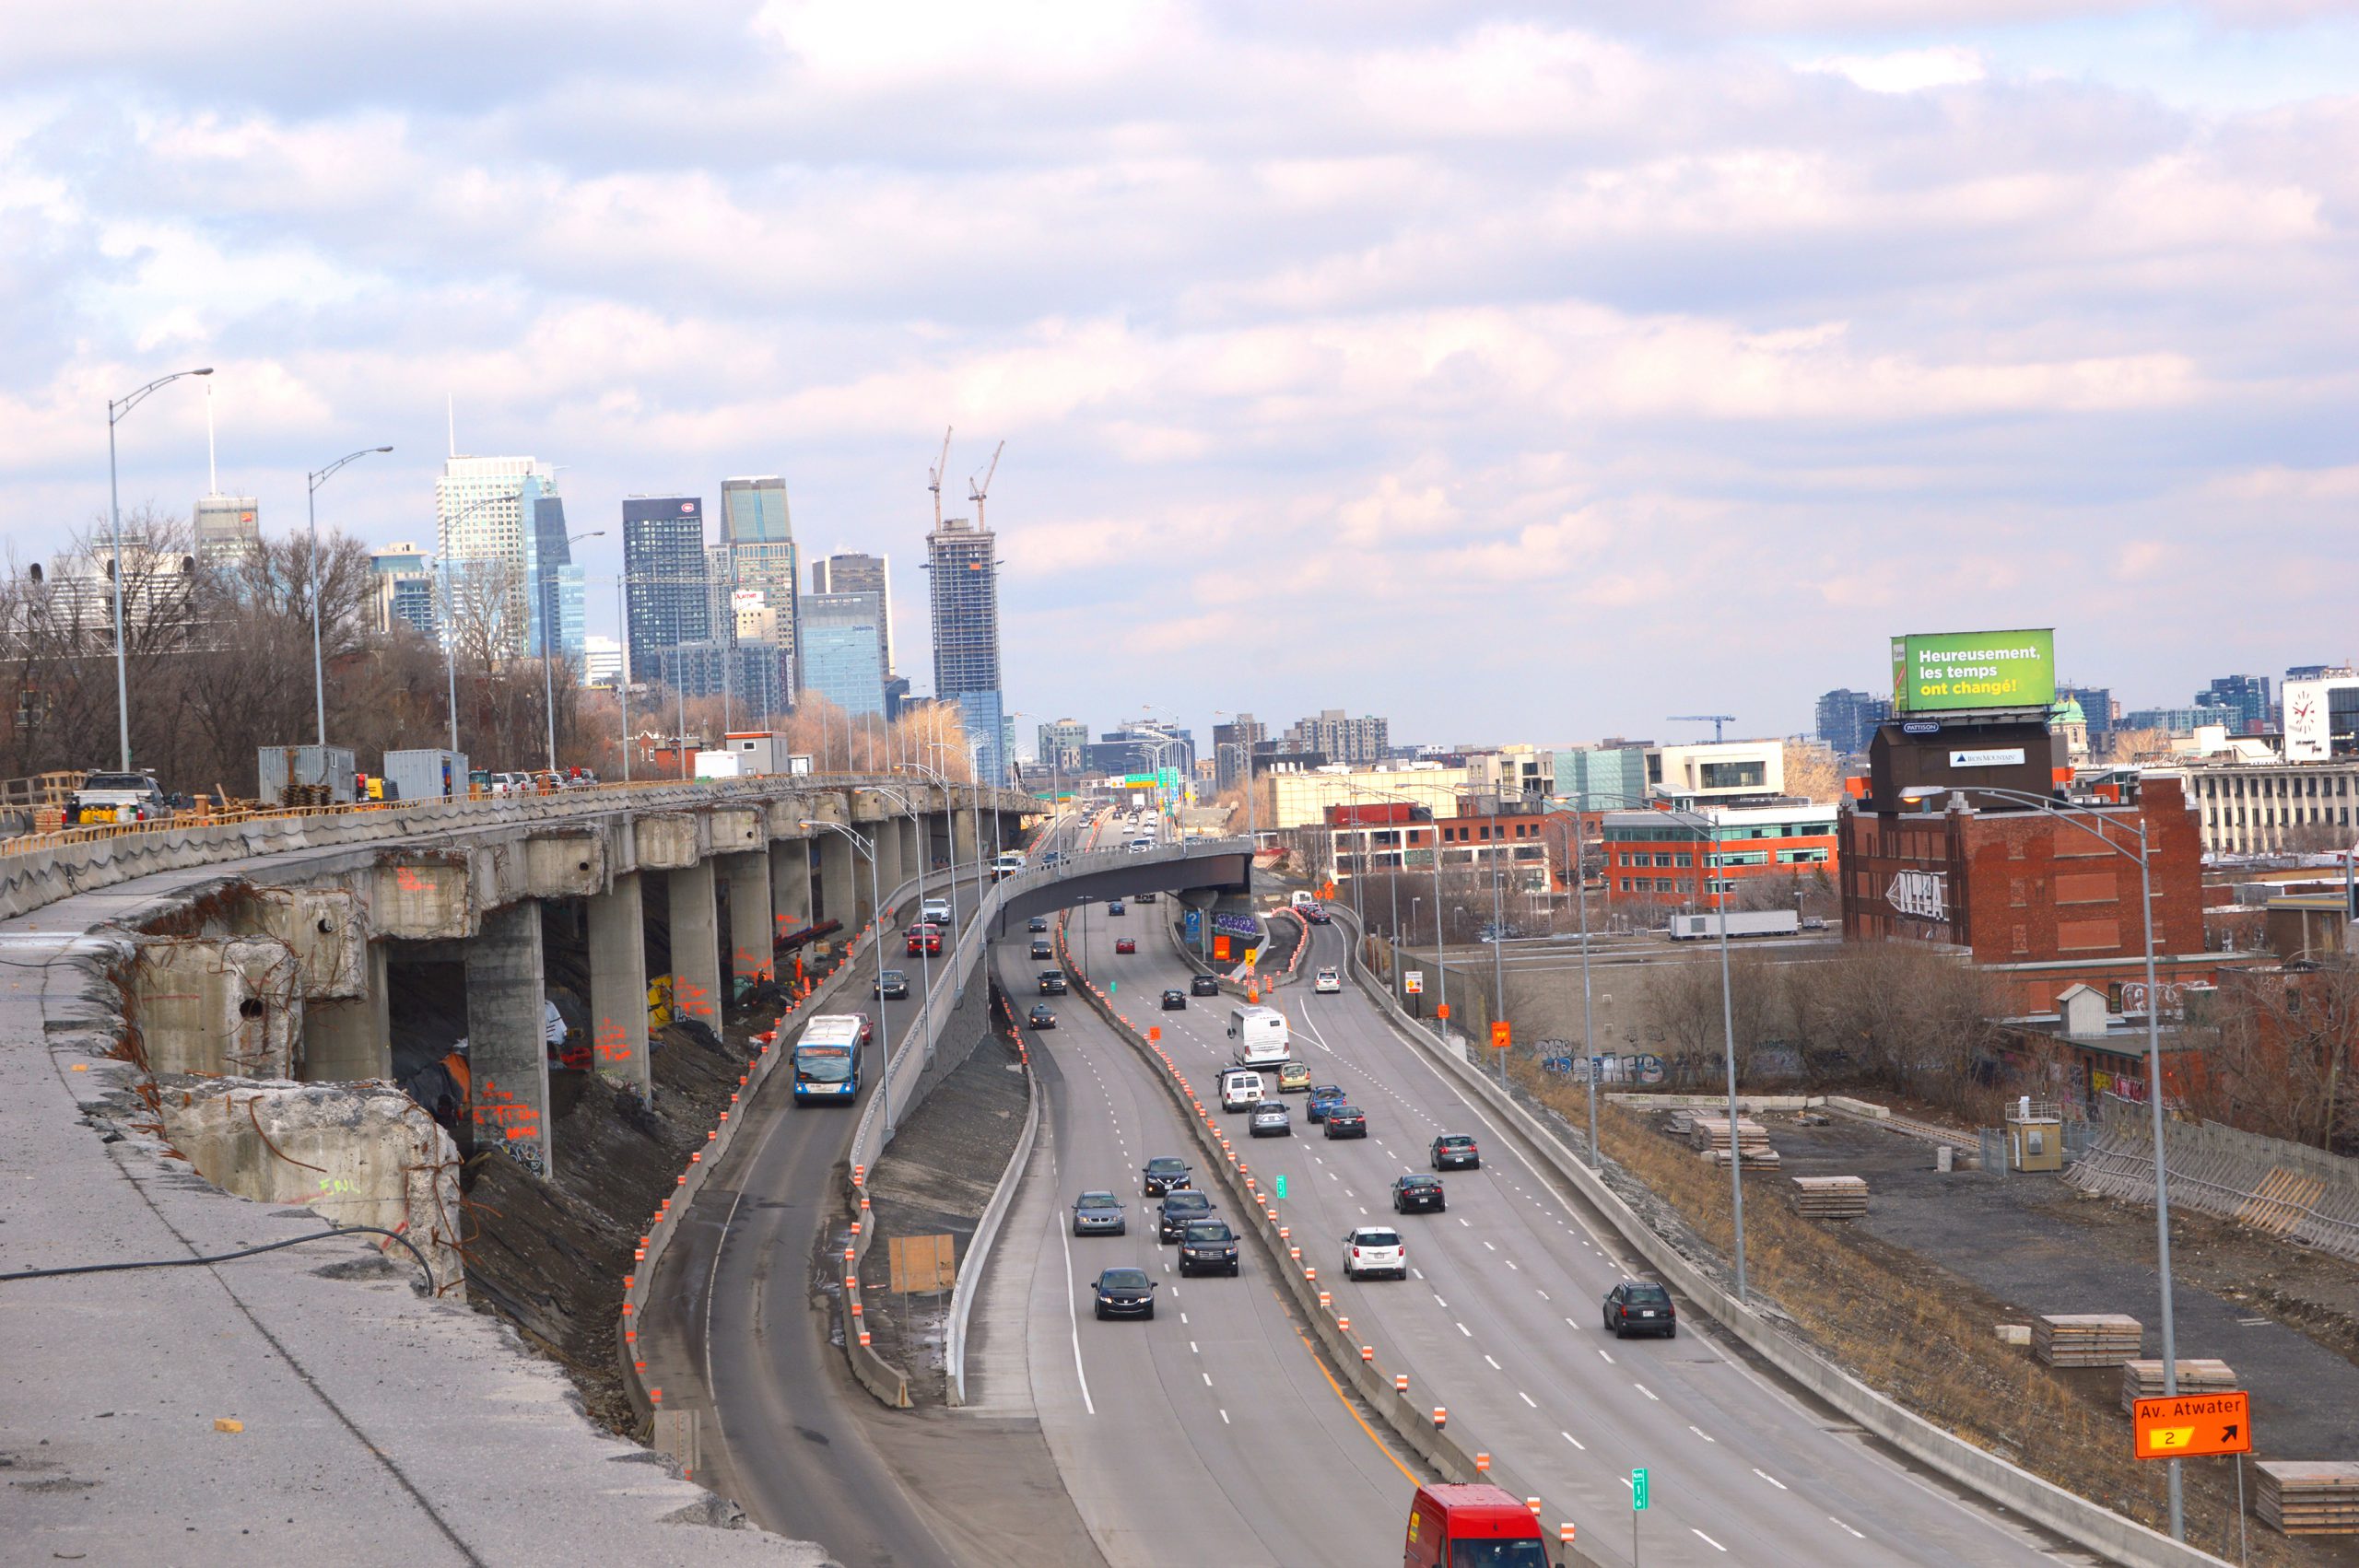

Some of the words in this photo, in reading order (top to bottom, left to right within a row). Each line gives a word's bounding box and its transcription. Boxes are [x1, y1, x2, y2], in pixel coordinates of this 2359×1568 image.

[1919, 646, 2041, 663] Heureusement,
[1919, 666, 1942, 679] les
[1947, 665, 1998, 680] temps
[1920, 682, 1949, 696] ont
[1953, 679, 2017, 696] changé!
[2141, 1406, 2165, 1419] Av.
[2174, 1399, 2241, 1417] Atwater
[2165, 1432, 2175, 1445] 2
